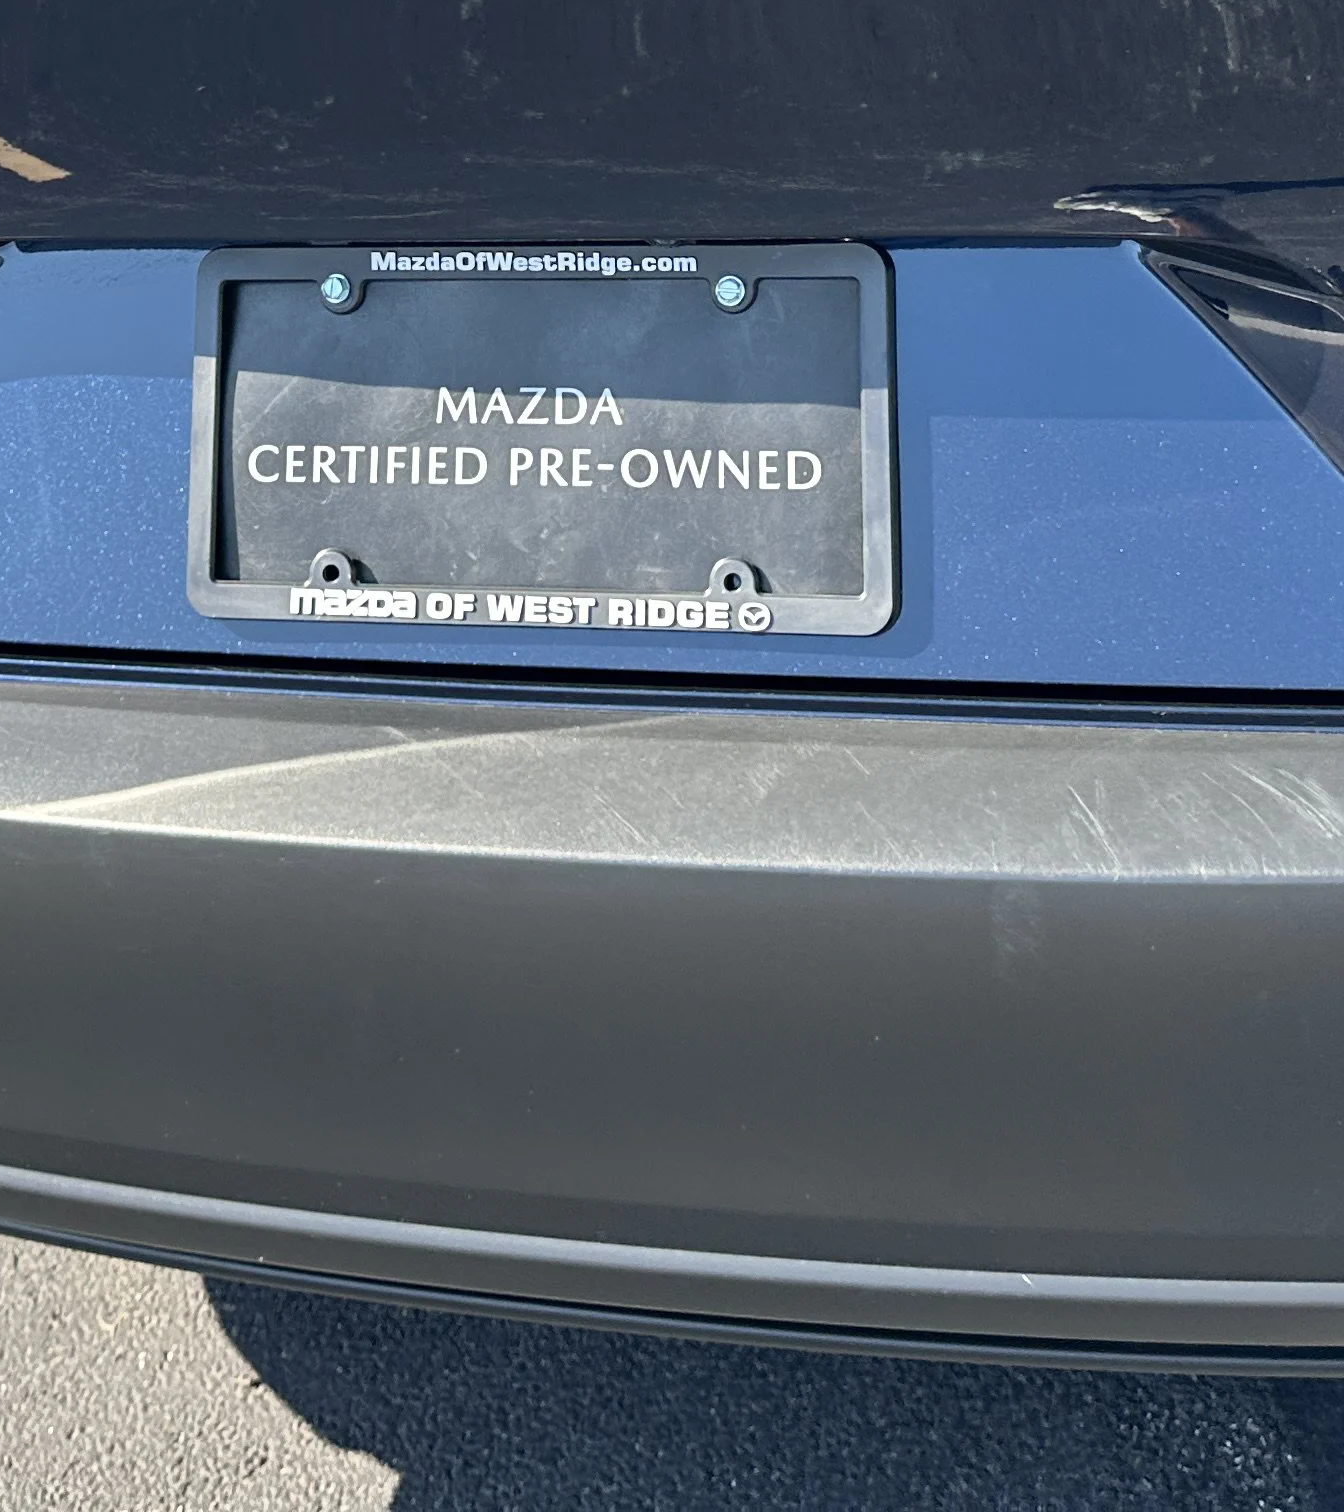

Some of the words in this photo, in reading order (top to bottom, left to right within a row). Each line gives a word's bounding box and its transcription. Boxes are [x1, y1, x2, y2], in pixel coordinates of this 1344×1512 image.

[370, 251, 698, 276] MazdaOfWestRidge.com
[435, 386, 624, 426] MAZDA
[247, 444, 488, 486] CERTIFIED
[509, 447, 823, 490] PRE-OWNED
[426, 592, 477, 621] OF
[486, 593, 598, 625] WEST
[608, 598, 732, 629] RIDGE
